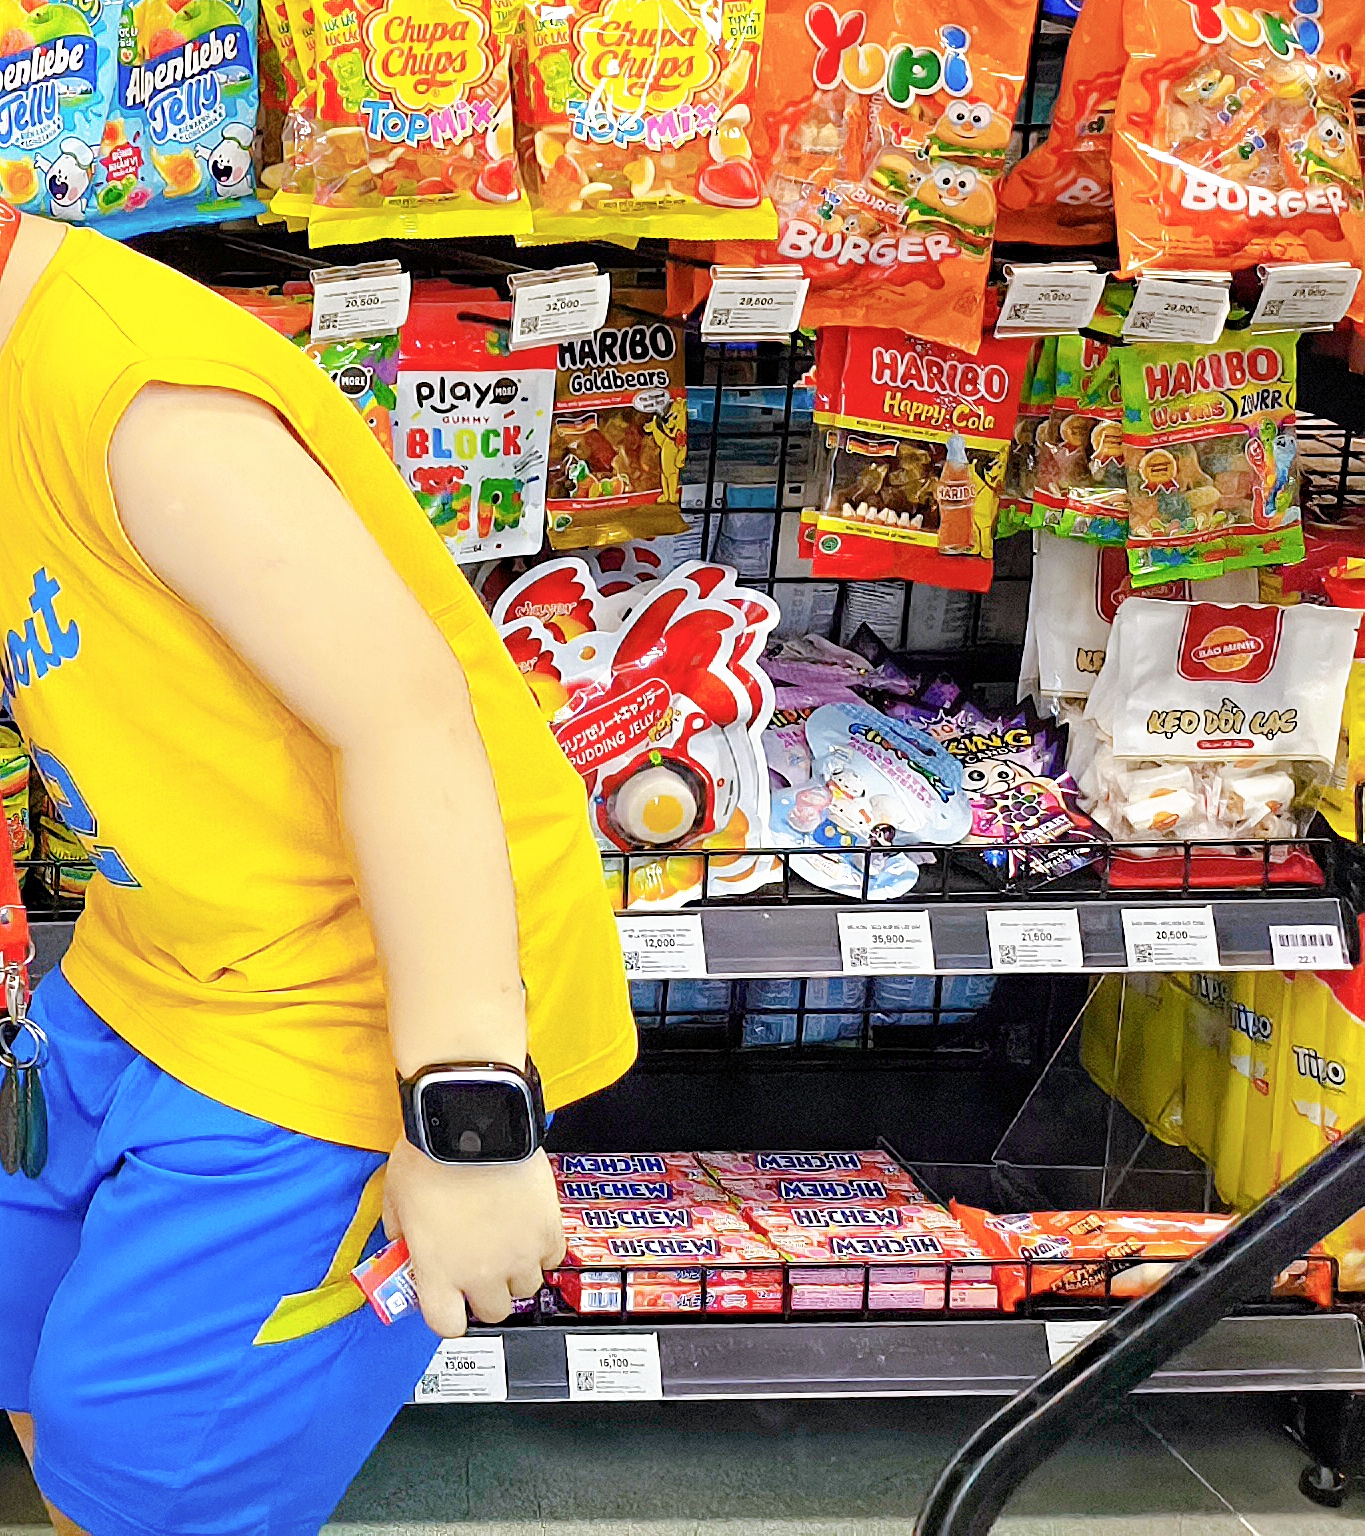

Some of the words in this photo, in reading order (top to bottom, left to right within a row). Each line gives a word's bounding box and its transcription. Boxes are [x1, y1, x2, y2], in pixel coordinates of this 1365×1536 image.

[383, 19, 468, 53] Chupa
[126, 35, 239, 102] Alpenliebe
[380, 51, 467, 85] Chups
[806, 2, 973, 108] Yupi
[149, 72, 221, 136] Jelly
[1181, 173, 1349, 220] BURGER
[778, 220, 961, 266] BURGER
[558, 324, 674, 367] HARIBO
[570, 368, 668, 394] Goldbears
[873, 347, 1009, 401] HARIBO
[1145, 346, 1282, 401] HARIBO
[416, 381, 491, 414] play
[1149, 400, 1226, 429] Worms
[1238, 387, 1284, 418] ZOURR
[442, 415, 490, 425] GUMMY
[406, 426, 524, 461] BLOCK
[1148, 709, 1198, 736] KẸO
[644, 937, 676, 949] 12,000
[1155, 930, 1189, 941] 20,500
[442, 1358, 477, 1372] 13,000
